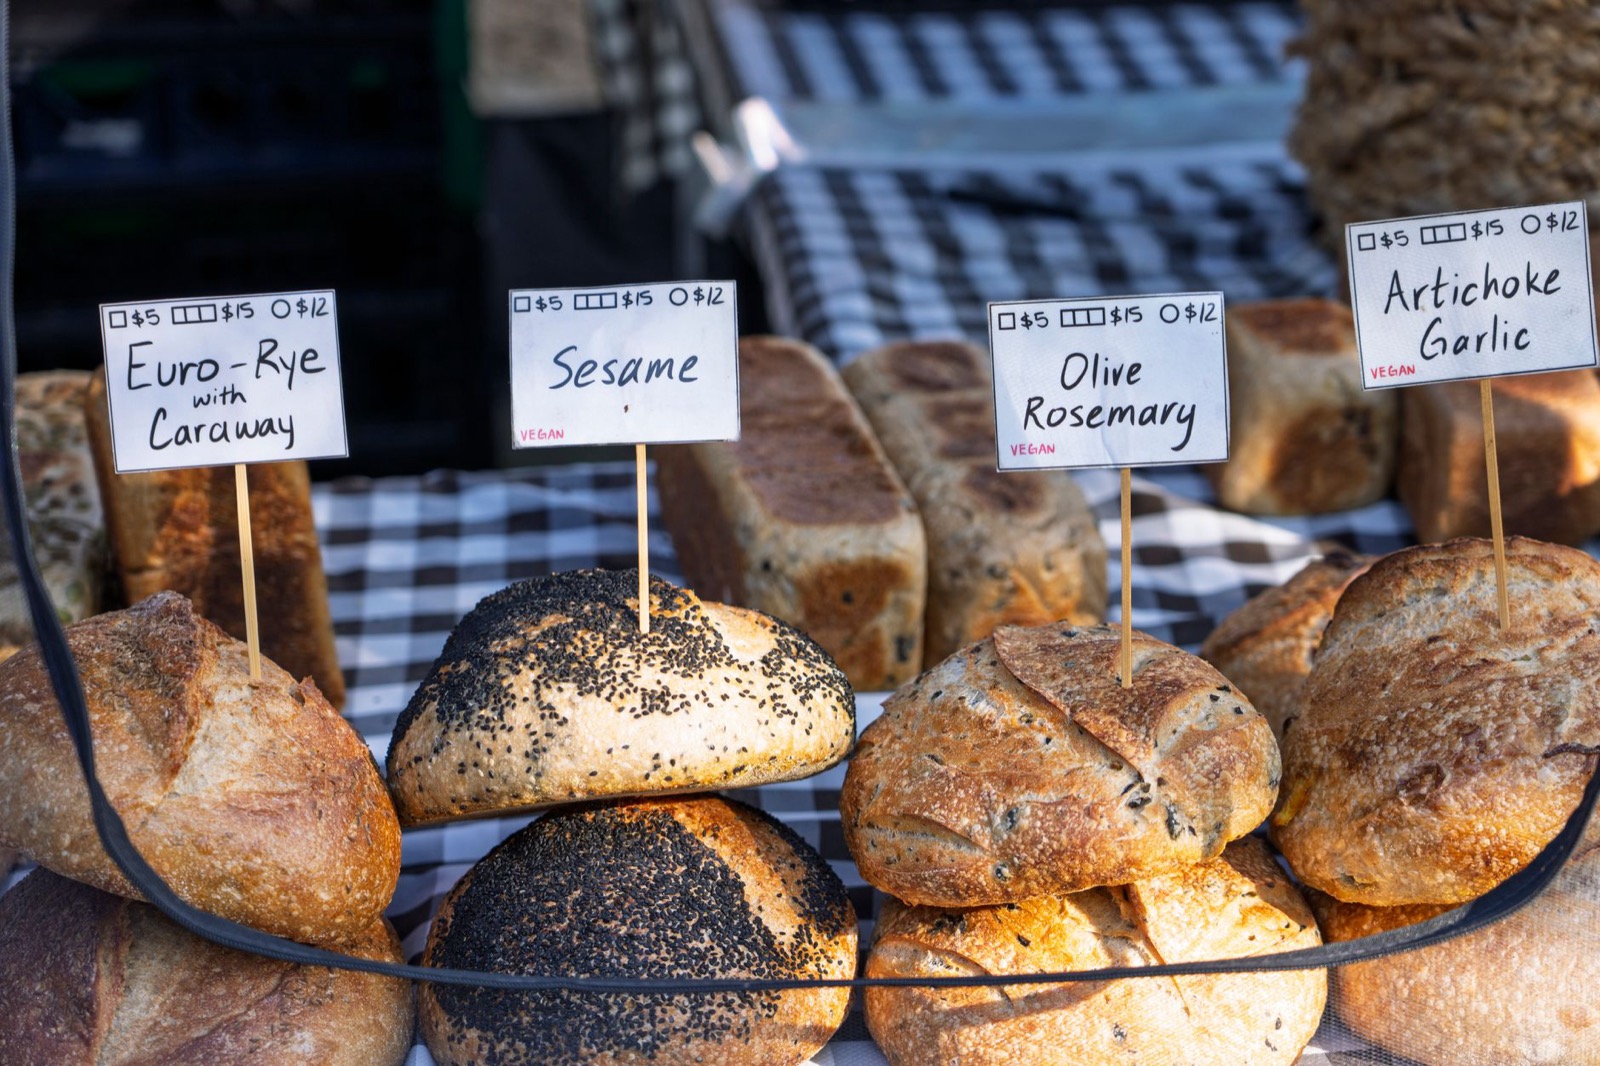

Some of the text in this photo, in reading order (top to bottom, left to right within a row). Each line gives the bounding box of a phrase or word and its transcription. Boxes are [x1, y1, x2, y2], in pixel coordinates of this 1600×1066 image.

[1380, 211, 1579, 249] $5 $15 $12
[535, 286, 724, 313] $5 $15 $12
[1384, 261, 1561, 314] Artichoke
[131, 297, 329, 328] $5 $15 $12
[1020, 302, 1218, 330] $5 $15 $12
[1420, 314, 1531, 360] Garlic
[548, 345, 699, 390] Sesame
[1060, 352, 1142, 391] Olive
[1370, 364, 1416, 379] VEGAN
[193, 383, 247, 408] with
[150, 407, 295, 450] Caraway
[520, 428, 564, 441] VEGAN
[1024, 396, 1196, 452] Rosemary
[1010, 443, 1055, 456] VEGAN
